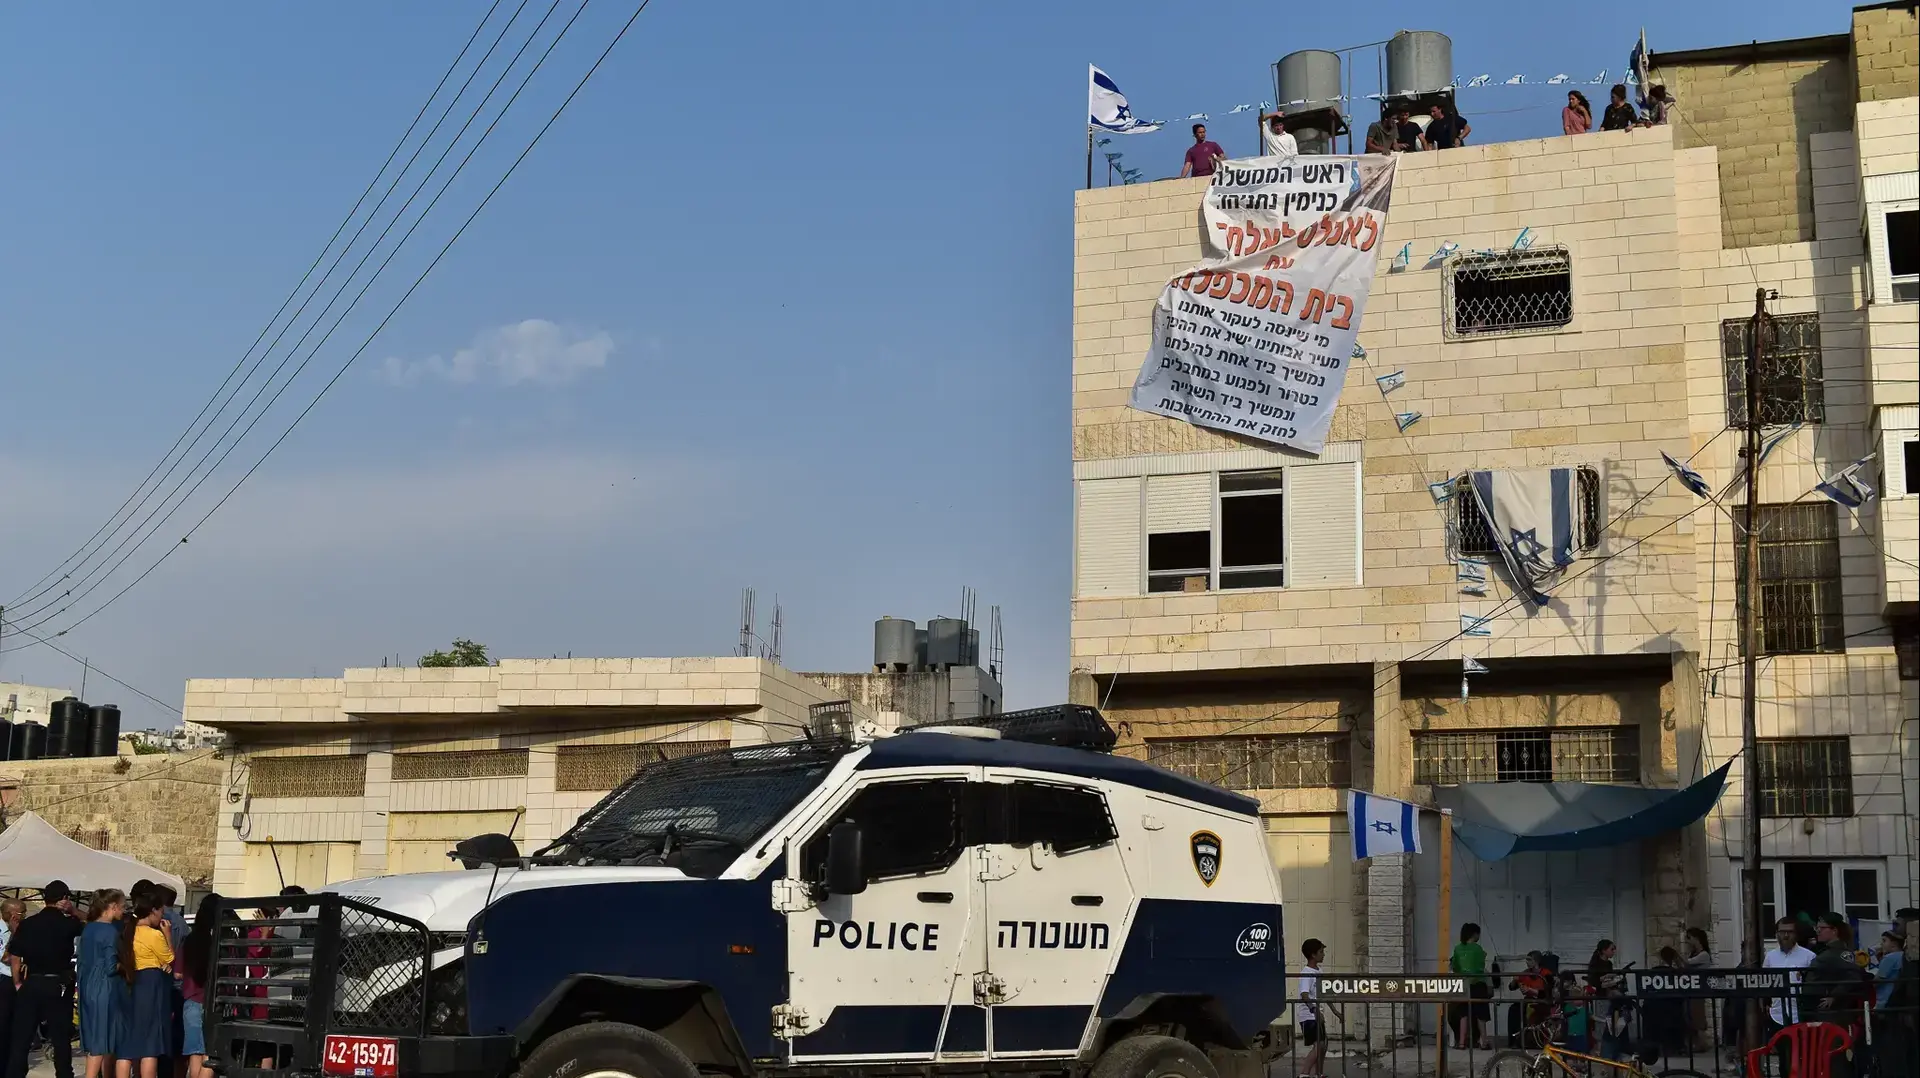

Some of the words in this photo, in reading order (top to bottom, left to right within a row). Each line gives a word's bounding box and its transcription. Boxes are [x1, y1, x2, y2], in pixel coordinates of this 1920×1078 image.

[1211, 165, 1293, 187] הממשלה
[1302, 163, 1344, 184] ראש
[1178, 300, 1215, 319] אותנו
[1299, 288, 1354, 330] בית
[1220, 310, 1261, 329] לעקור
[1200, 325, 1222, 340] את
[1223, 331, 1252, 345] ישיג
[1264, 321, 1309, 343] שינסה
[1314, 334, 1330, 348] מי
[1165, 336, 1213, 358] להילחם
[1254, 338, 1304, 361] אבותינו
[1217, 350, 1249, 368] אחת
[1254, 358, 1277, 375] ביד
[1309, 352, 1341, 369] מעיר
[1224, 373, 1271, 396] ולפגוע
[1282, 365, 1326, 387] נמשיך
[1170, 380, 1215, 402] השנייה
[1278, 387, 1319, 406] בטרור
[1220, 393, 1243, 409] ביד
[1248, 400, 1296, 421] ונמשיך
[1234, 418, 1258, 431] את
[1259, 423, 1297, 439] לחזק
[813, 919, 939, 951] POLICE
[998, 920, 1110, 950] משטרה
[1249, 928, 1268, 940] 100
[1240, 939, 1266, 951] בשבילך
[1321, 979, 1380, 994] POLICE
[1404, 979, 1464, 994] משטרה
[1641, 975, 1700, 990] POLICE
